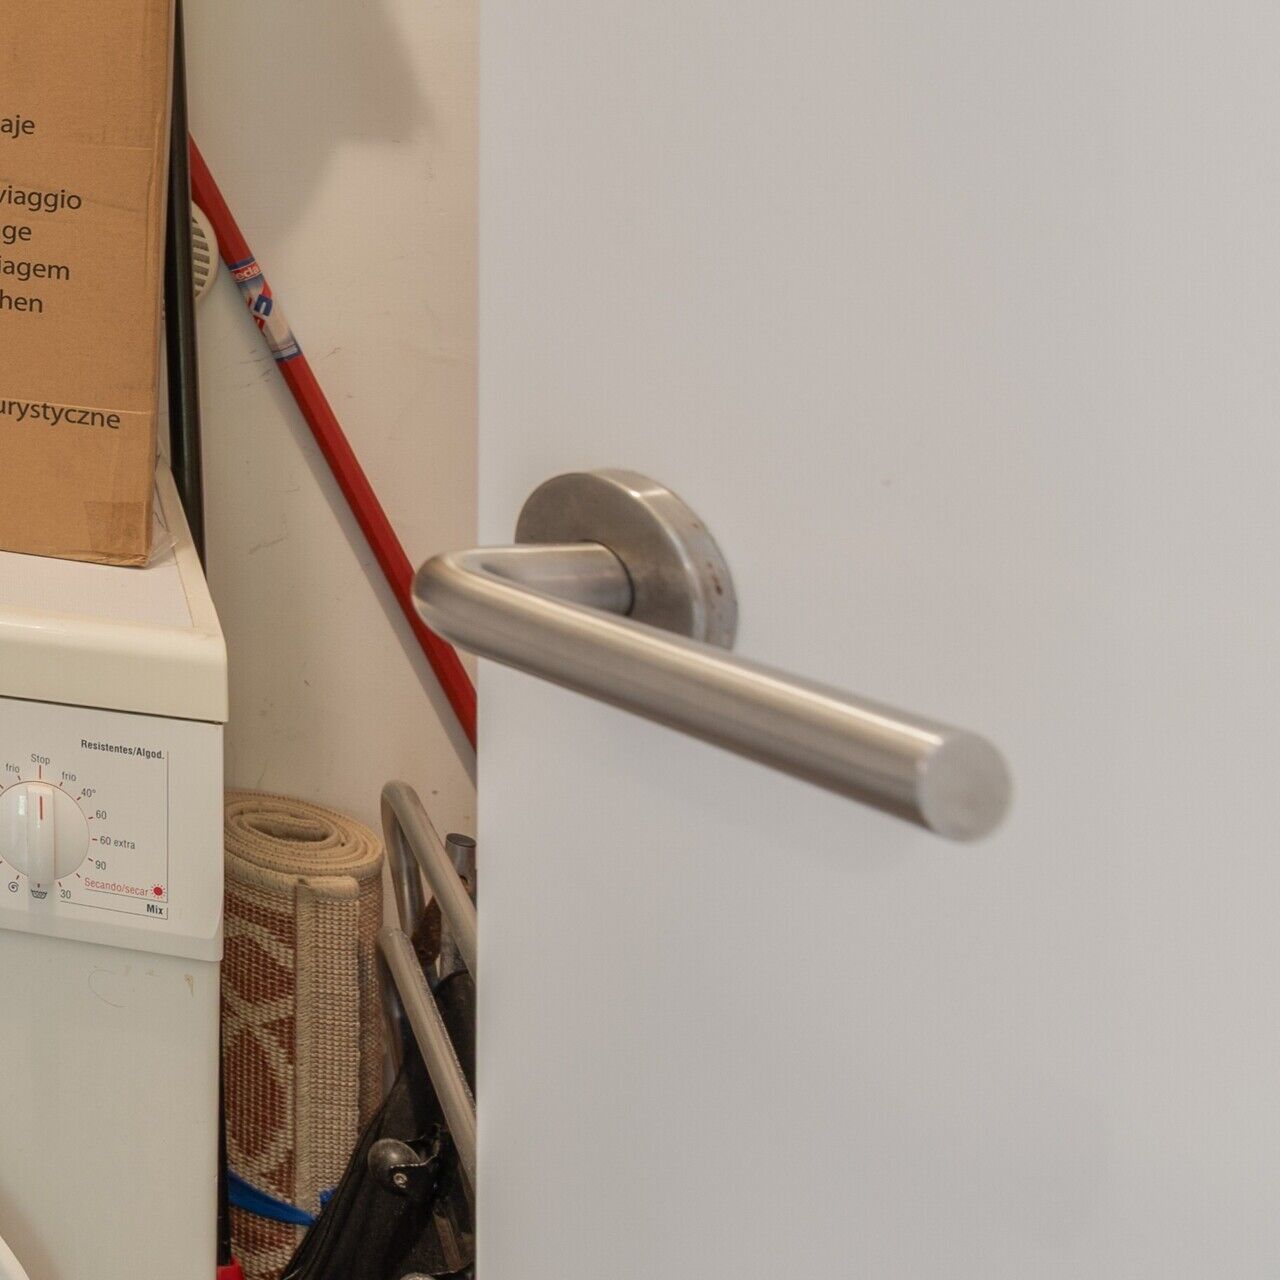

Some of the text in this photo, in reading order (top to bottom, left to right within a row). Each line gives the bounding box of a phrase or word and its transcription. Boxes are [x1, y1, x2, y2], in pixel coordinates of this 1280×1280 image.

[81, 739, 165, 760] Resistentes/Algod.
[31, 753, 51, 766] Stop
[95, 810, 107, 820] 60
[100, 836, 136, 850] 60 extra
[95, 860, 107, 870] 90
[84, 877, 148, 897] Secando/secar
[60, 889, 72, 899] 30
[146, 904, 163, 915] Mix
